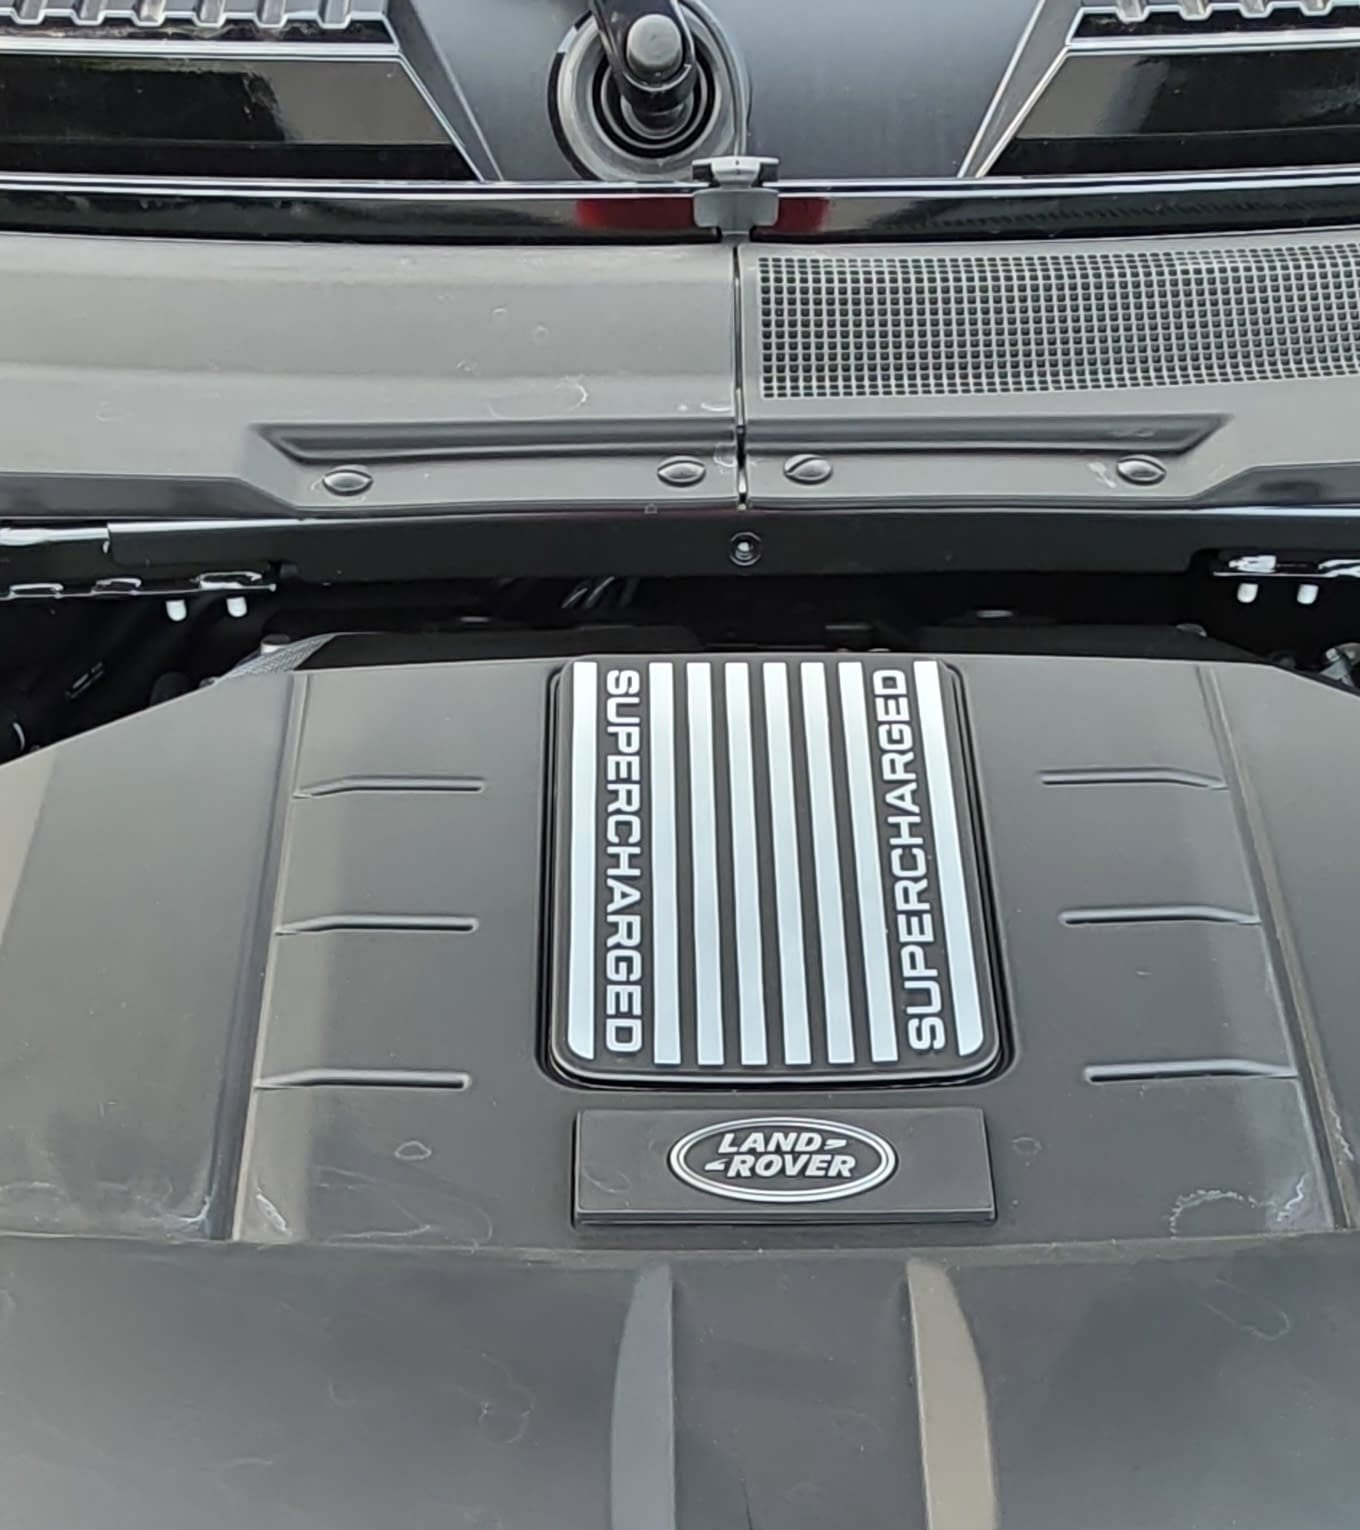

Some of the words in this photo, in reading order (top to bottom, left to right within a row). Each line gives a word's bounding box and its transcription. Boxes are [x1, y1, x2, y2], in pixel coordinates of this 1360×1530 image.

[606, 669, 642, 1052] SUPERCHARGED
[872, 669, 945, 1050] SUPERCHARGED
[718, 1132, 822, 1153] LAND
[727, 1154, 856, 1177] ROVER
